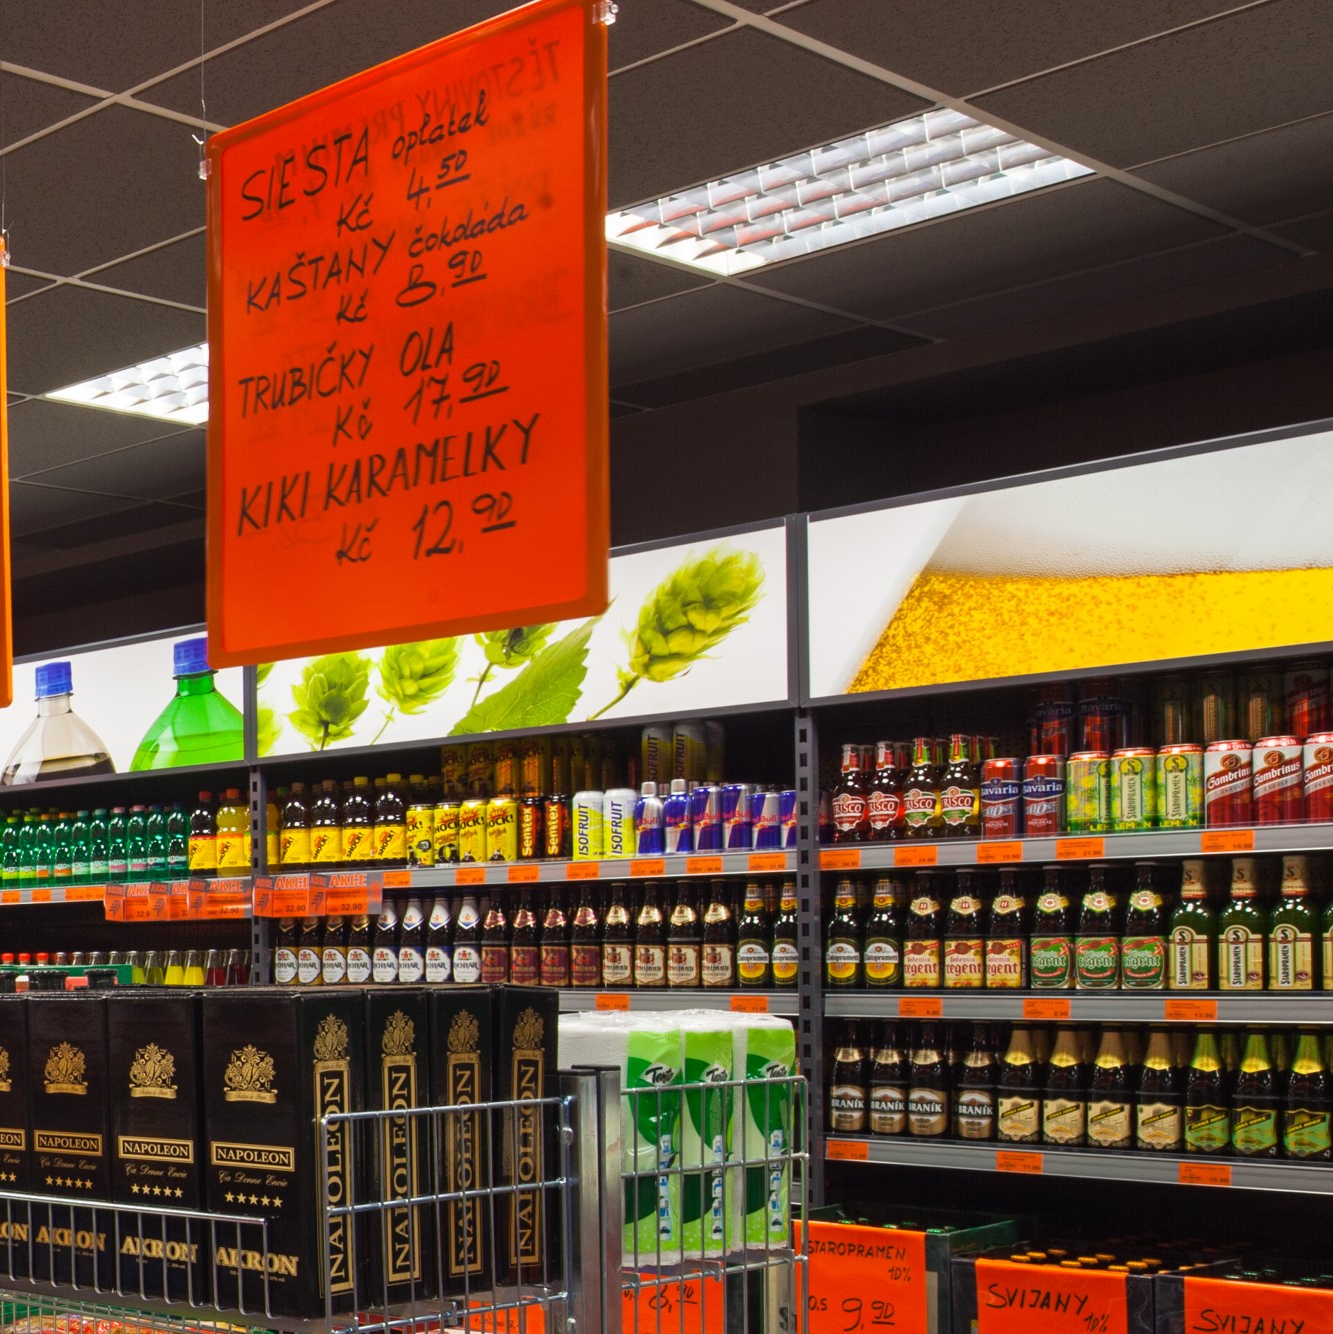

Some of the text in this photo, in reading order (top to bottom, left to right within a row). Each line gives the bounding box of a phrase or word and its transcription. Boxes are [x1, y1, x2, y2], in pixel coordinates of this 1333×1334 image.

[241, 127, 369, 220] SIESTA
[392, 89, 490, 166] oplatek
[337, 193, 373, 237] Kč
[246, 232, 395, 313] KAŠTANY
[336, 290, 368, 324] Kč
[238, 321, 454, 418] TRUBIČKY OLA
[332, 402, 374, 447] Kč
[237, 414, 540, 536] KIKI KARAMELKY
[337, 519, 375, 566] Kč
[1254, 760, 1301, 786] Gambrinus
[547, 804, 558, 855] Semtex
[578, 803, 589, 856] ISOFRUIT
[612, 801, 622, 854] ISOFRUIT
[210, 881, 243, 892] AKCE
[330, 874, 367, 887] AKCE
[341, 903, 362, 911] 32.90
[871, 1100, 905, 1111] BRANÍK
[959, 1103, 993, 1116] BRANÍK
[38, 1134, 98, 1150] NAPOLEON
[123, 1141, 189, 1157] NAPOLEON
[216, 1148, 289, 1165] NAPOLEON
[234, 1173, 262, 1185] Donne
[264, 1176, 288, 1188] Envie
[322, 1076, 348, 1280] NAPOLEON
[36, 1226, 106, 1252] AKRON
[120, 1235, 197, 1263] AKRON
[808, 1240, 906, 1260] STAROPRAMEN
[888, 1266, 911, 1282] 10%
[985, 1284, 1110, 1333] SVIJANY 10%
